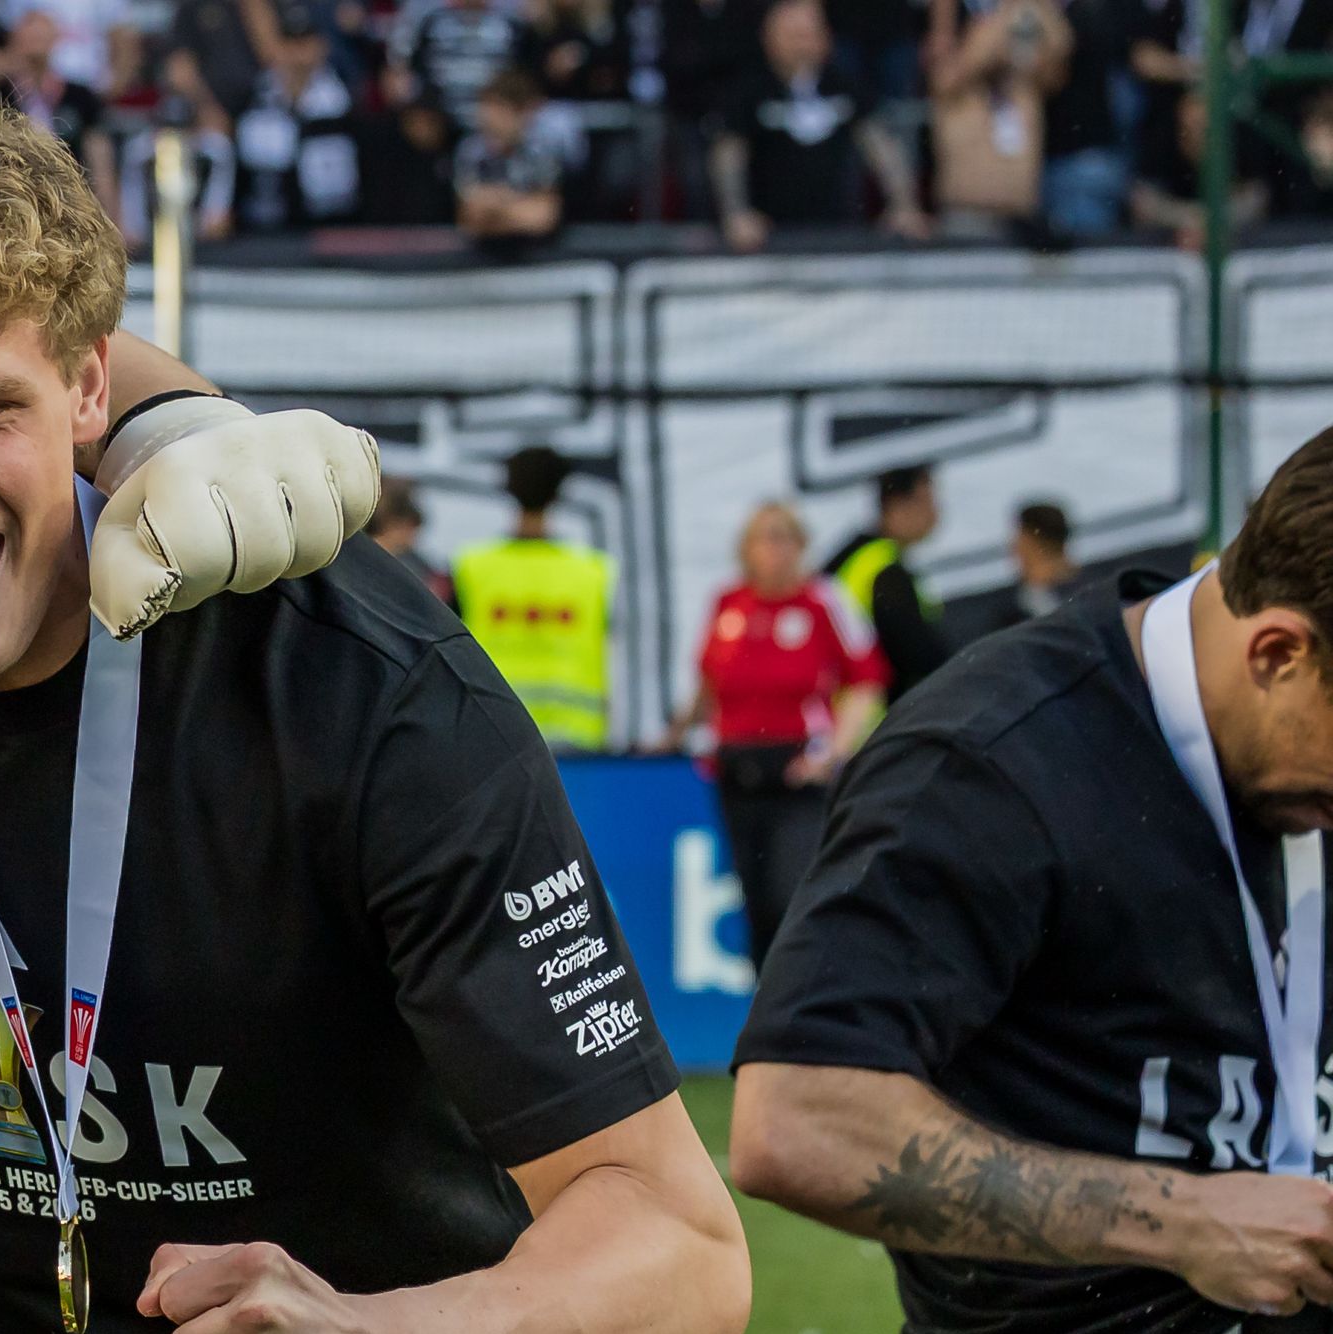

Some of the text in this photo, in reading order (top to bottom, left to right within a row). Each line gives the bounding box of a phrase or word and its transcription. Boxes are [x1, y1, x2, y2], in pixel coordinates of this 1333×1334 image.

[531, 860, 585, 911] BWT
[565, 965, 627, 1006] Raiffeisen
[565, 999, 642, 1056] Zipfer
[7, 1165, 58, 1194] HER!
[75, 1178, 255, 1201] FB-CUP-SIEGER
[17, 1193, 36, 1216] &
